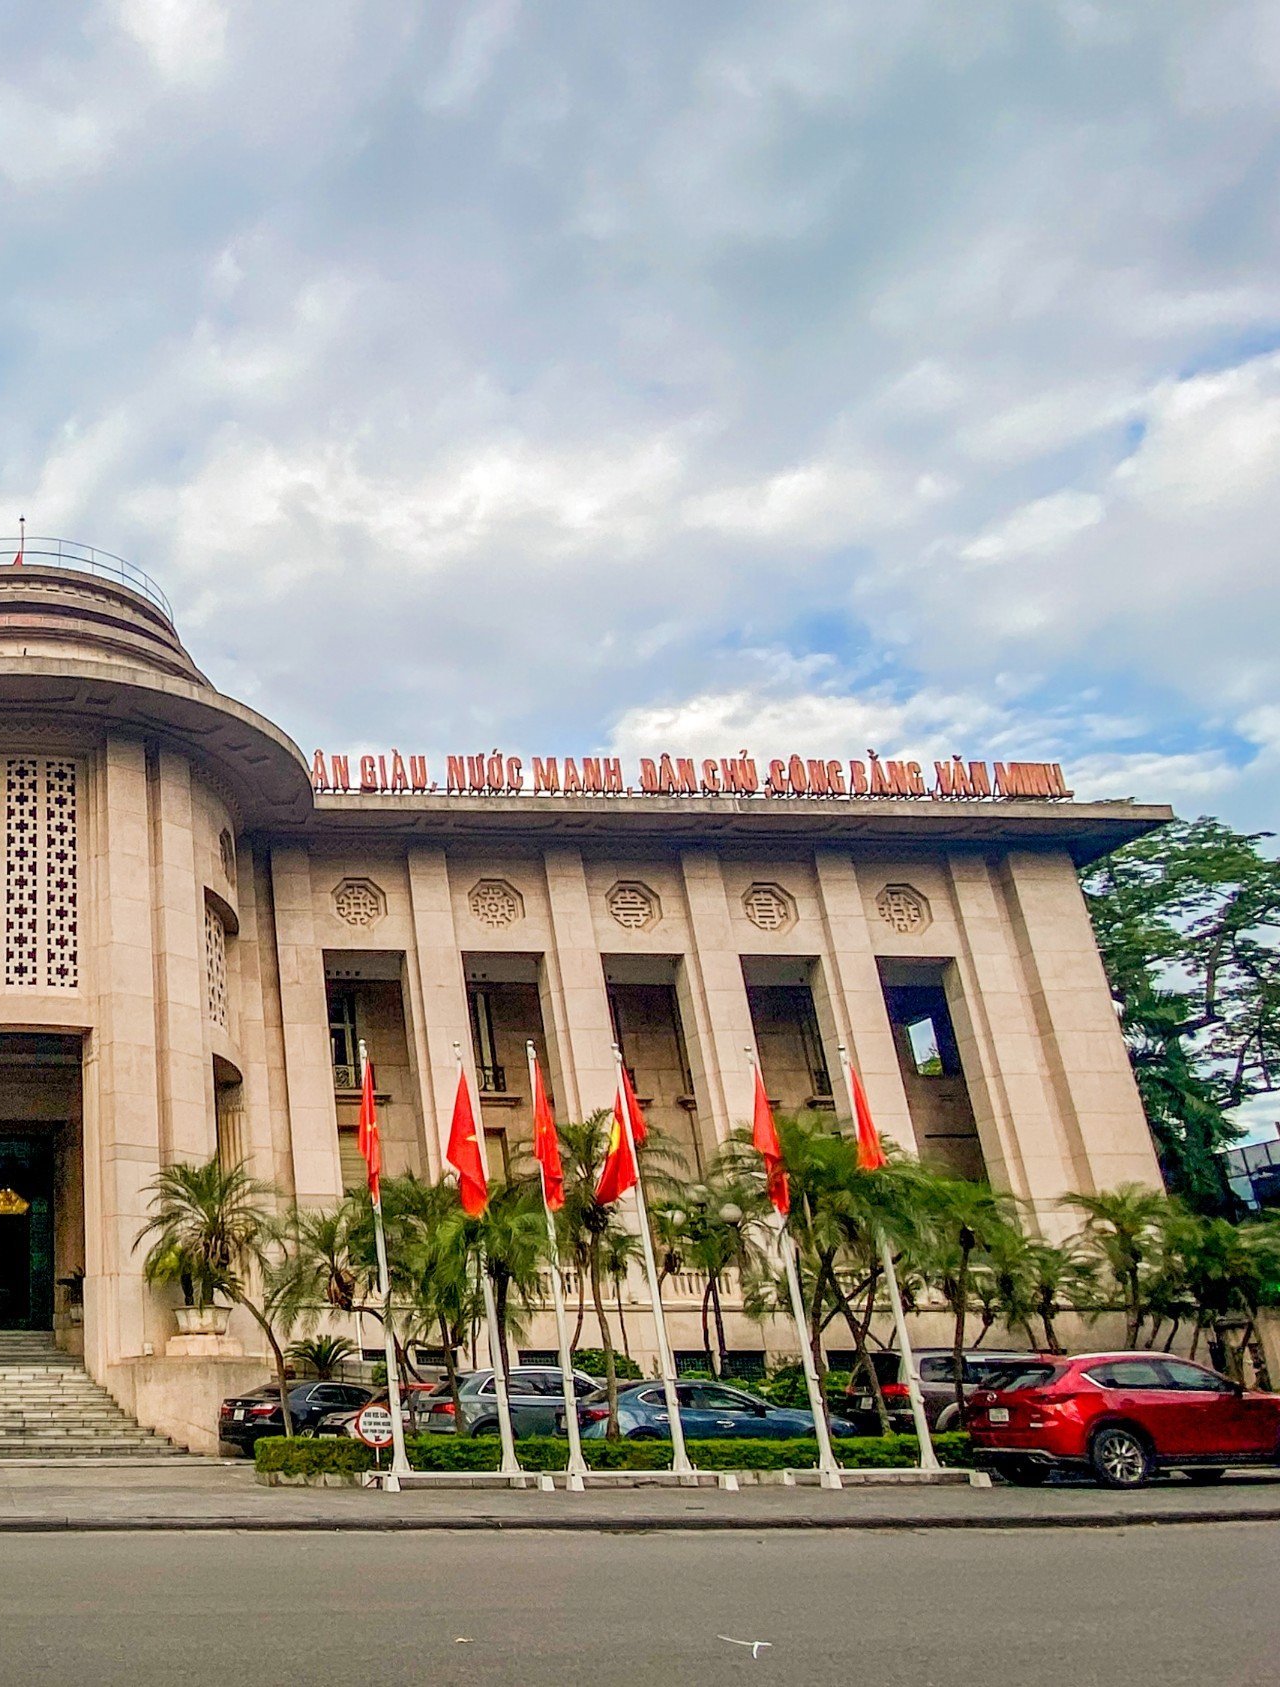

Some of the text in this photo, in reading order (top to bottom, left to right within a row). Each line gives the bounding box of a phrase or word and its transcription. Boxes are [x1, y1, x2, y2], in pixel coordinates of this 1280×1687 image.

[312, 749, 349, 790] ÂN
[447, 748, 524, 790] NƯỚC
[640, 753, 698, 793] DÂN
